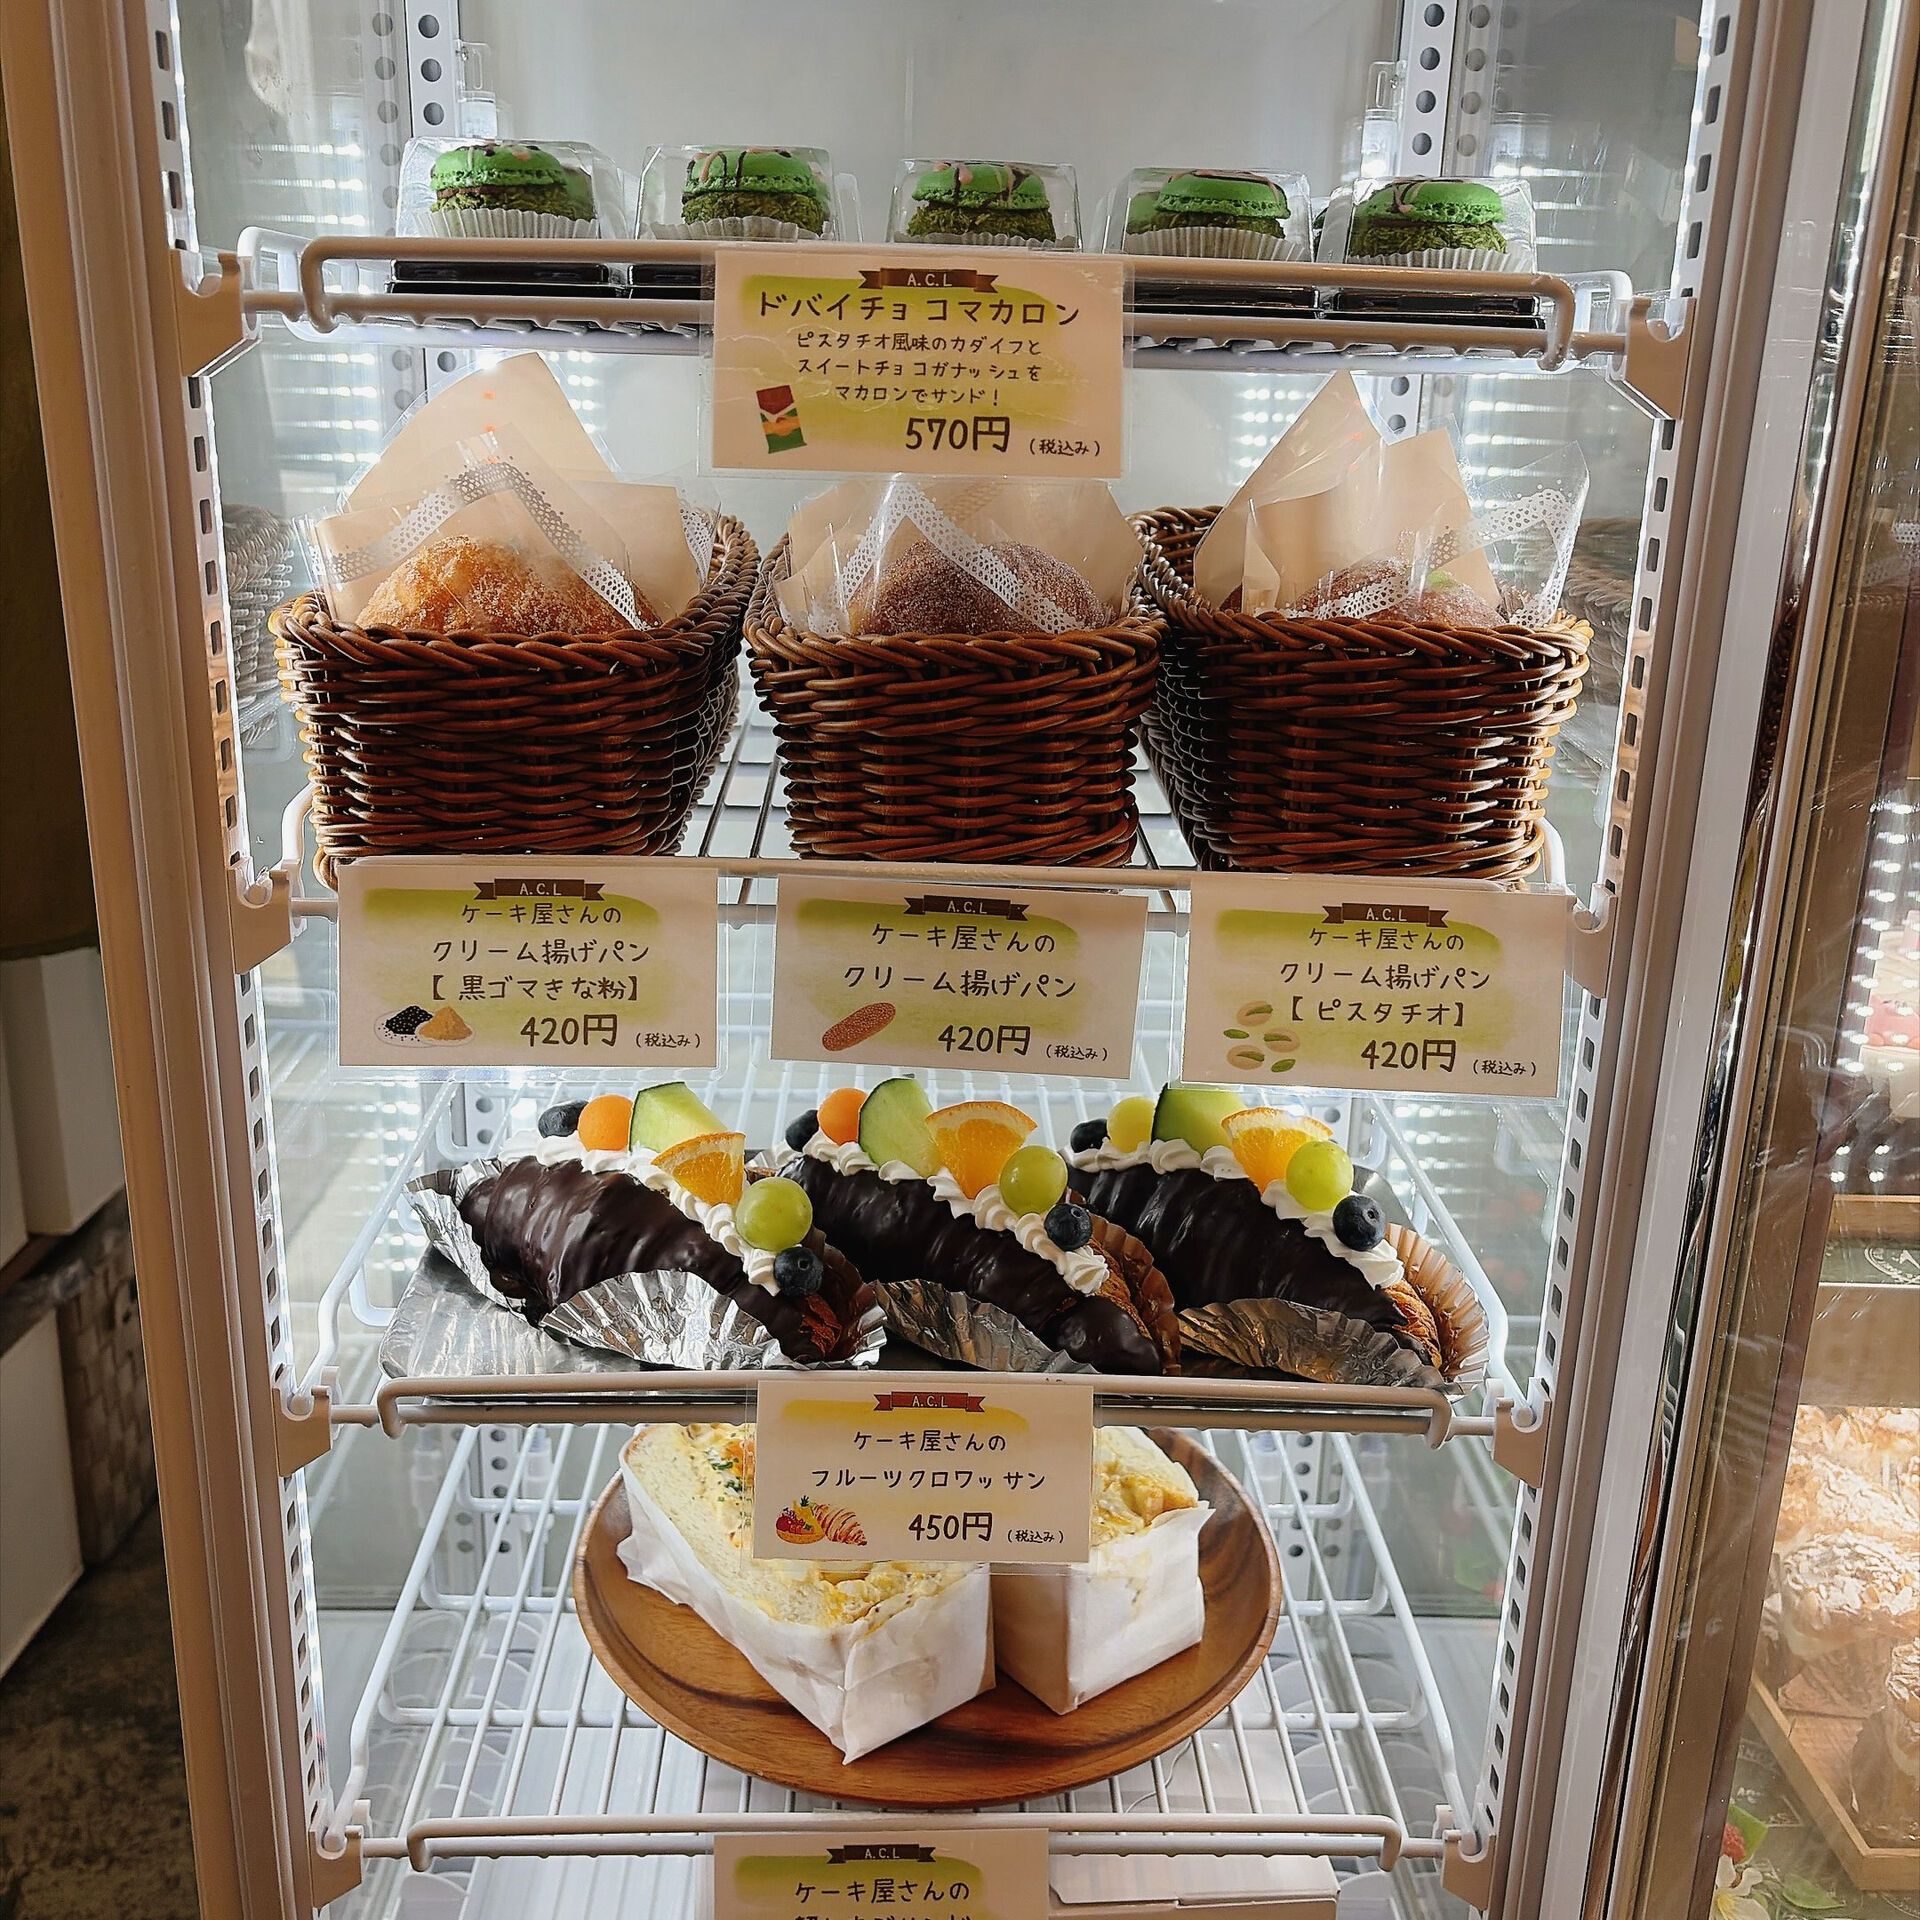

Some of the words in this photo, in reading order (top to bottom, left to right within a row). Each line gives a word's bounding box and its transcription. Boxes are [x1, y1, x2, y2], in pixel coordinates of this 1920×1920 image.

[907, 273, 953, 288] A.C.L
[759, 292, 1080, 326] ドバイチョコマカロン
[798, 333, 1041, 356] ピスタチオ風味のカダイフと
[798, 359, 1041, 381] スイートチョコガナッシュを
[836, 386, 999, 406] マカロンでサンド！
[905, 416, 1010, 452] 570円
[1029, 439, 1101, 457] （税込み）
[519, 883, 562, 896] A.C.L
[461, 903, 621, 925] ケーキ屋さんの
[947, 901, 987, 915] A.C.L
[1366, 908, 1407, 922] A.C.L
[872, 923, 1055, 953] ケーキ屋さんの
[1309, 927, 1464, 951] ケーキ屋さんの
[433, 939, 649, 965] クリーム揚げパン
[432, 974, 639, 1001] 【黒ゴマきな粉】
[844, 966, 1076, 998] クリーム揚げパン
[1280, 962, 1490, 990] クリーム揚げパン
[1291, 996, 1463, 1027] 【ピスタチオ】
[520, 1013, 618, 1047] 420円
[635, 1032, 701, 1048] （税込み）
[937, 1024, 1031, 1056] 420円
[1046, 1044, 1108, 1061] （税込み）
[1360, 1039, 1456, 1072] 420円
[1472, 1059, 1536, 1077] （税込み）
[912, 1395, 948, 1408] A.C.L
[853, 1430, 1006, 1452] ケーキ屋さんの
[811, 1468, 1046, 1490] フルーツクロワッサン
[909, 1512, 993, 1541] 450円
[1007, 1530, 1064, 1543] （税込み）
[865, 1848, 899, 1859] A.C.L
[795, 1878, 969, 1904] ケーキ屋さんの
